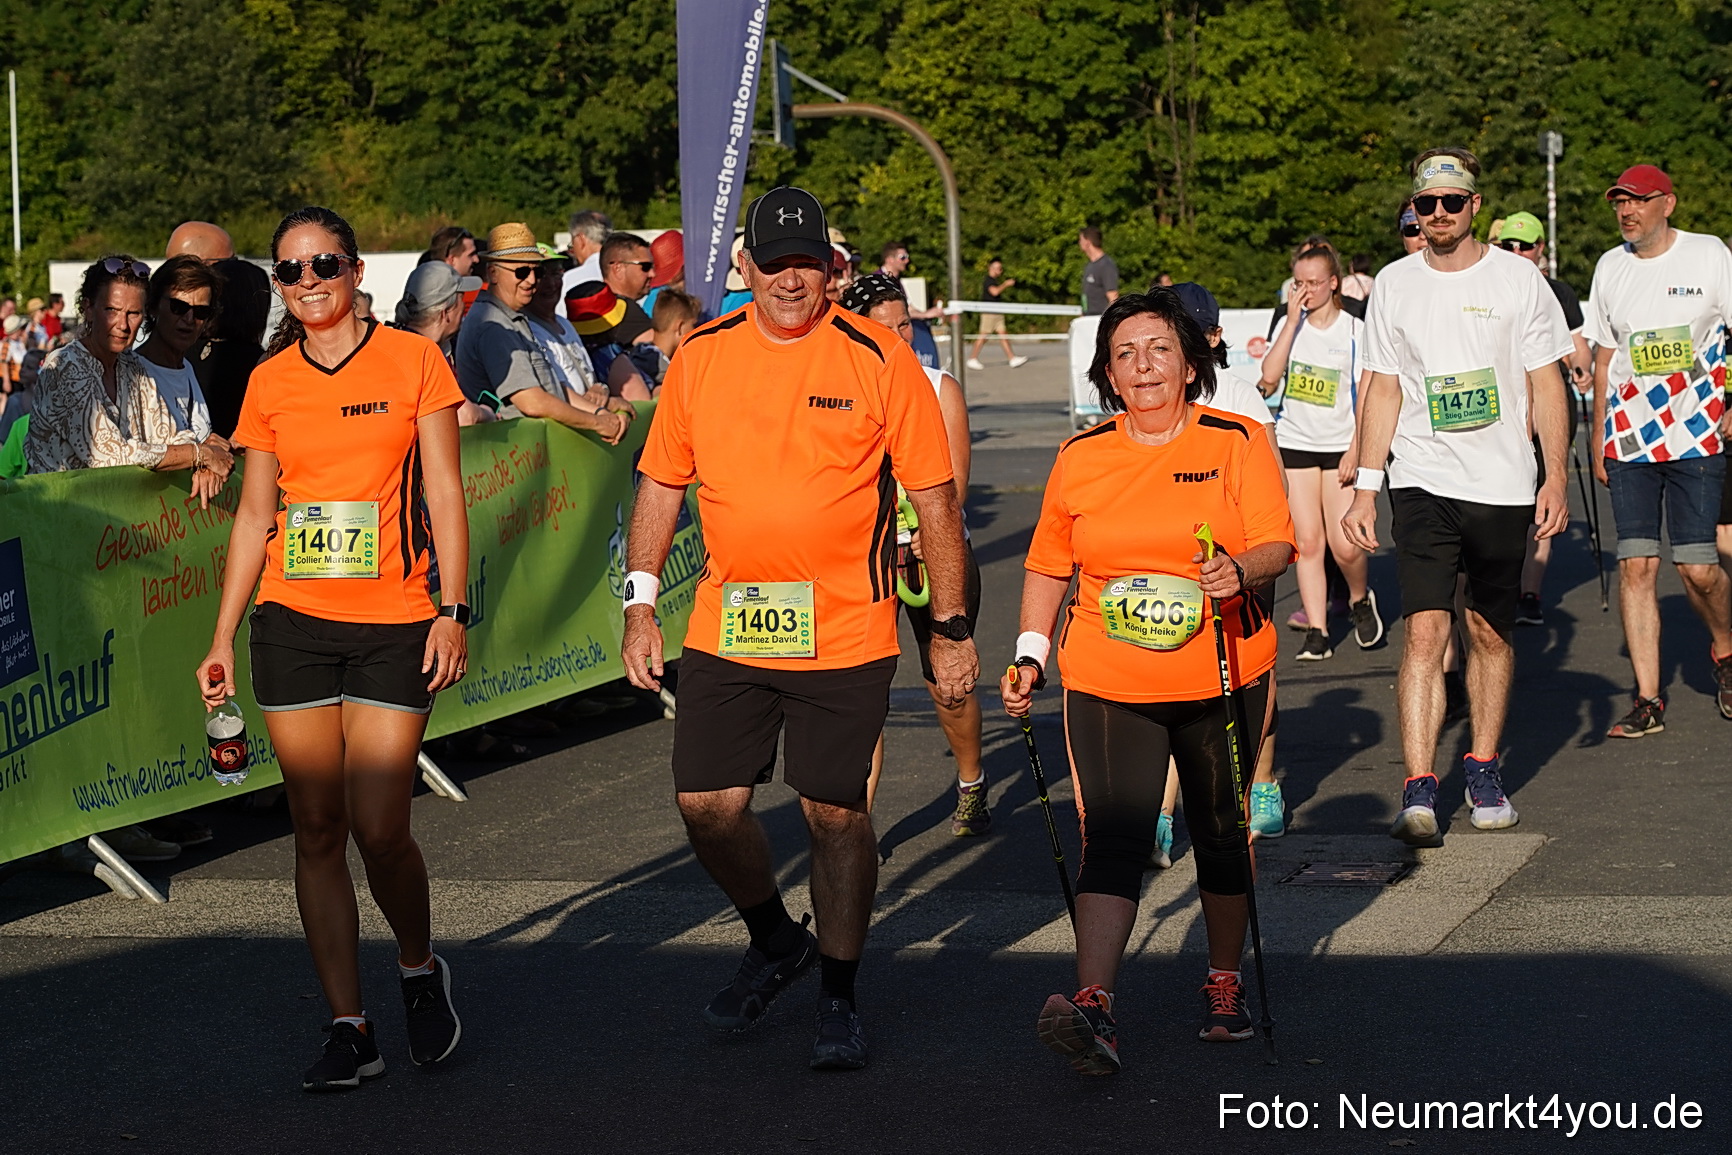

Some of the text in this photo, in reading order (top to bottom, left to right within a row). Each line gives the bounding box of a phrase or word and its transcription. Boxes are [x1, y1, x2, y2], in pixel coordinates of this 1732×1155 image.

[1641, 343, 1683, 361] 1068
[1299, 376, 1325, 393] 310
[341, 401, 389, 417] THULE
[808, 396, 854, 411] THULE
[1432, 401, 1440, 420] RUN
[1439, 389, 1488, 411] 1473
[1488, 389, 1498, 414] 2022
[1464, 408, 1485, 417] Daniel
[1173, 469, 1219, 483] THULE
[96, 495, 187, 571] Gesunde
[298, 528, 361, 553] 1407
[288, 533, 296, 569] WALK
[296, 555, 362, 564] Collier Mariana
[364, 532, 373, 566] 2022
[142, 554, 208, 617] laufen
[738, 609, 798, 632] 1403
[1105, 600, 1118, 631] WALK
[1117, 597, 1185, 626] 1406
[725, 612, 735, 647] WALK
[735, 635, 798, 644] Martinez David
[800, 612, 809, 646] 2022
[1124, 621, 1177, 637] König Heike
[1221, 660, 1231, 696] LEKI
